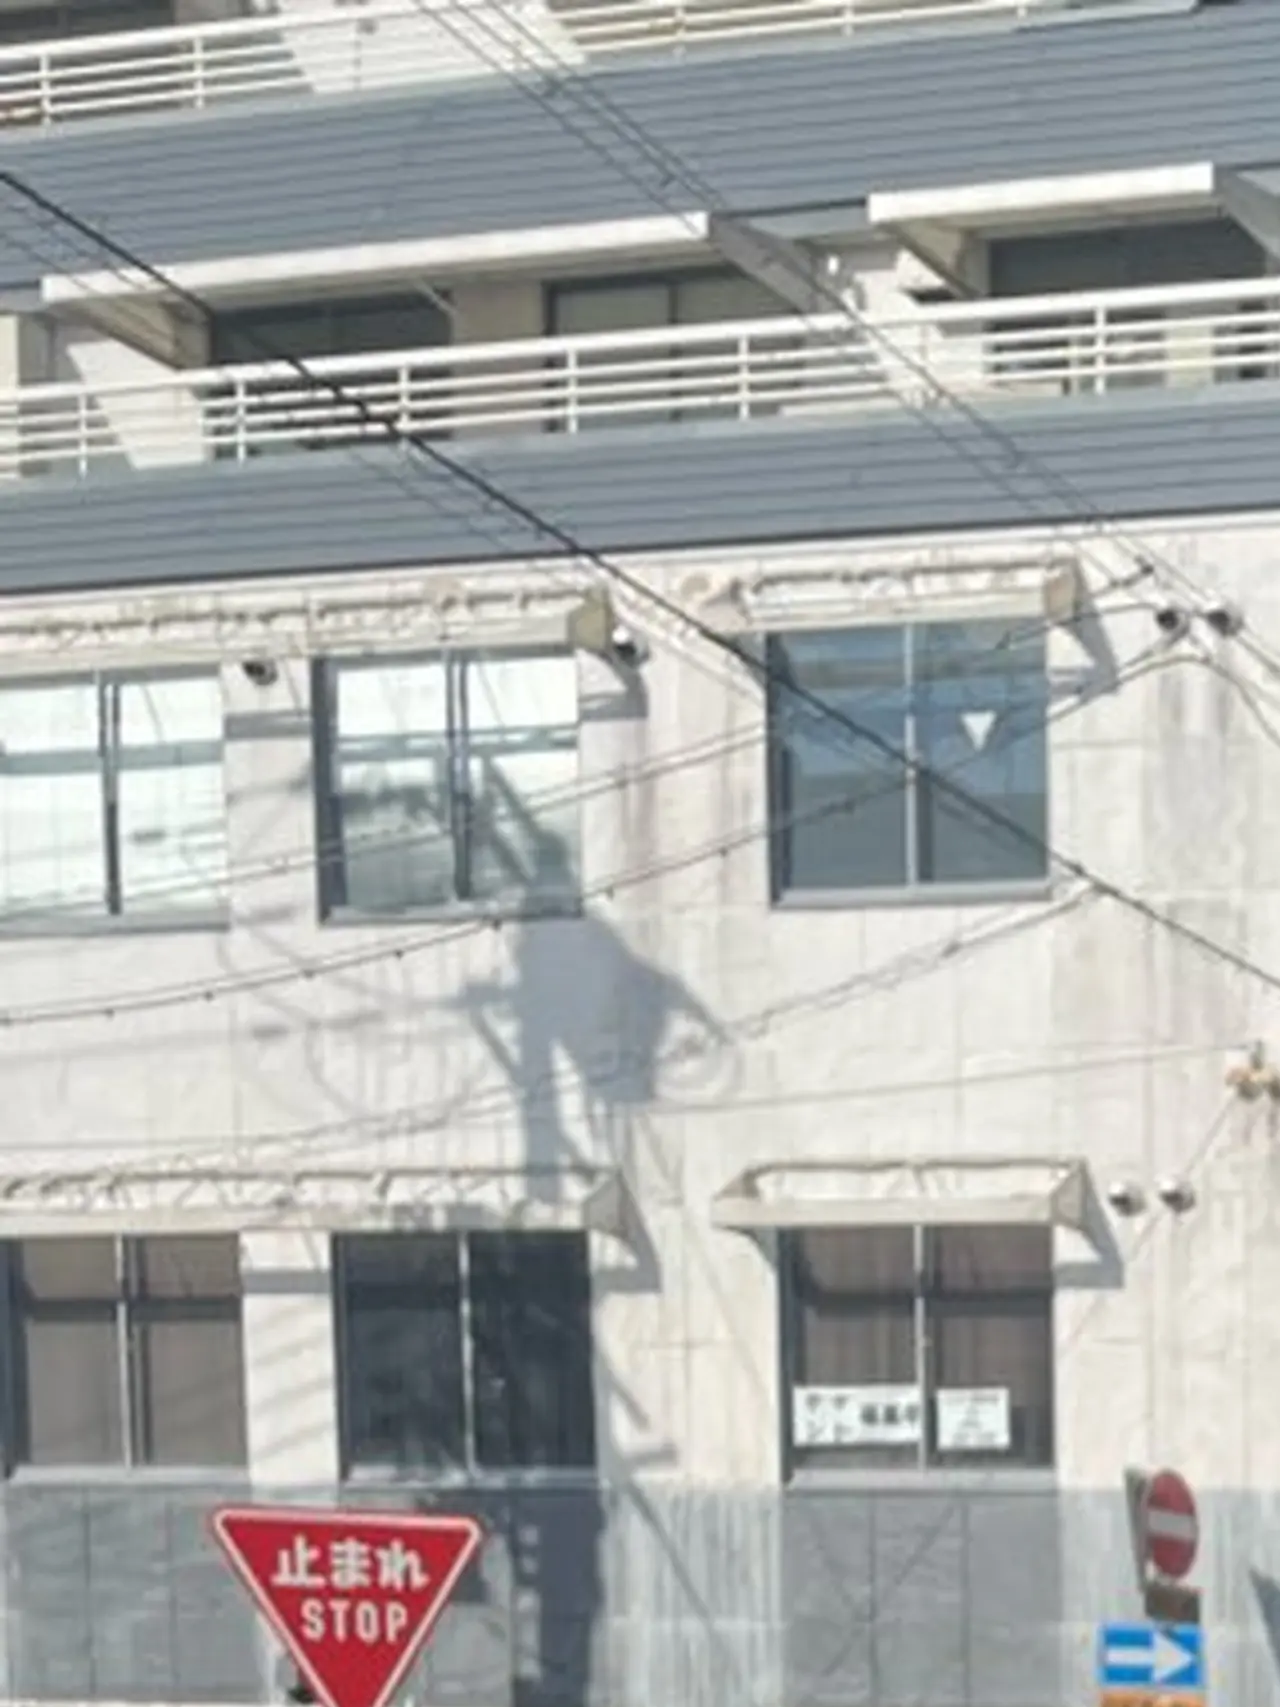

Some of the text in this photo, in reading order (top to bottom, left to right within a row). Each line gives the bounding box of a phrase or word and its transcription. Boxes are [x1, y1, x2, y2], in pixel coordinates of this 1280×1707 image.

[271, 1534, 430, 1590] 止まれ
[300, 1599, 408, 1643] STOP
